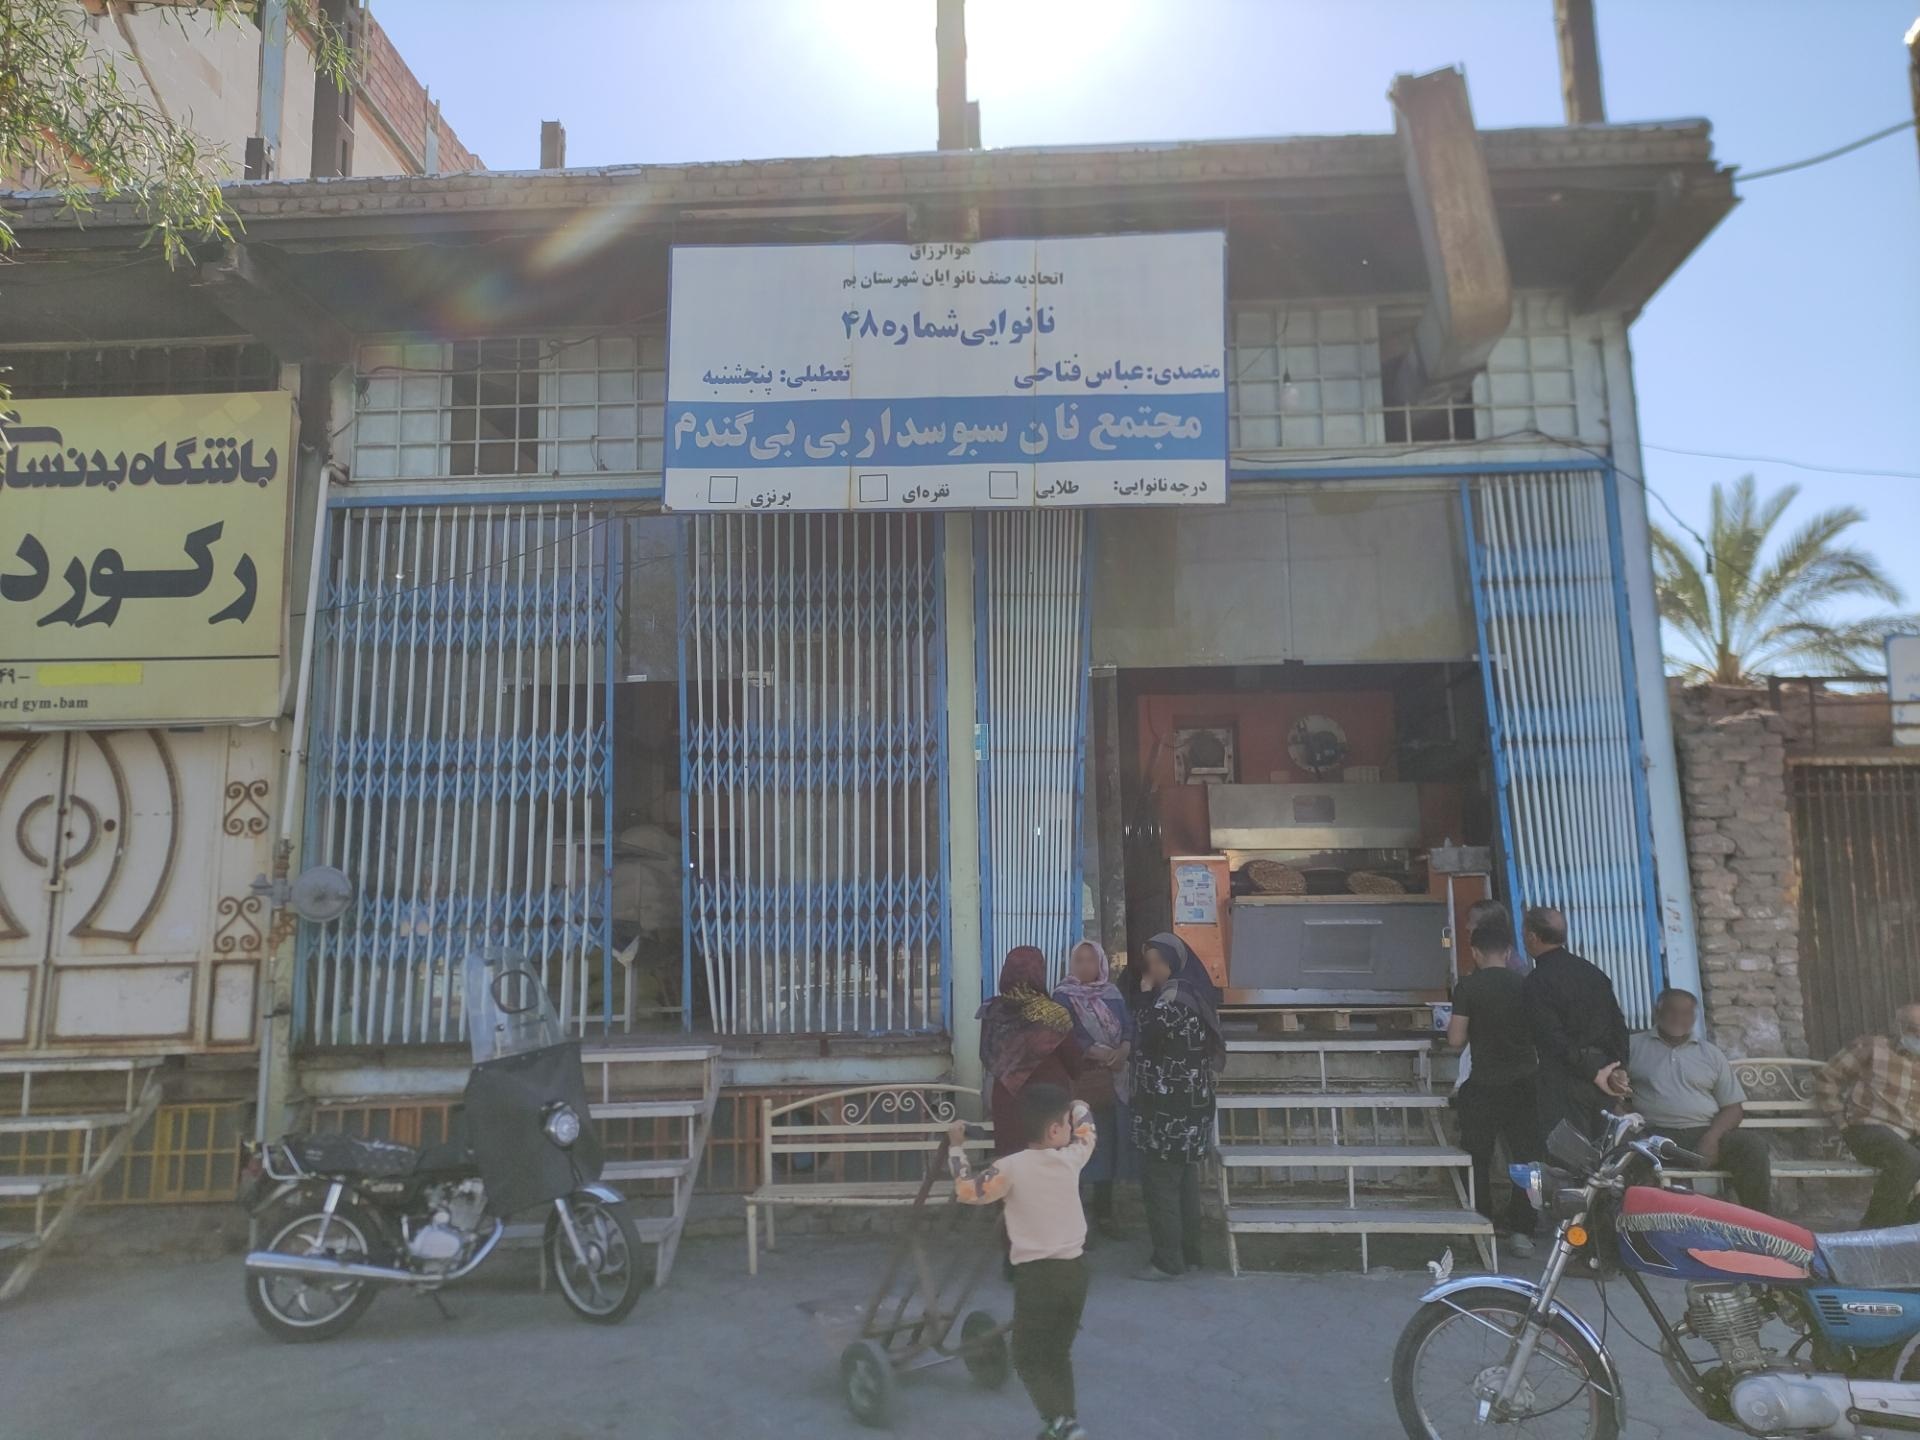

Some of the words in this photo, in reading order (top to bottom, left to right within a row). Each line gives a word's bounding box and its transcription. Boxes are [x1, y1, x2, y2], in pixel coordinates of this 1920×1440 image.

[842, 275, 857, 289] بم
[860, 270, 919, 289] شهرستان
[921, 269, 976, 288] نانوایان
[979, 274, 1012, 285] صنف
[1014, 271, 1064, 289] اتحادیه
[841, 309, 879, 340] ۴۸
[882, 309, 959, 345] شماره
[960, 305, 1055, 347] نانوایی
[702, 363, 774, 396] پنجشنبه
[779, 364, 851, 393] تعطیلی:
[1014, 353, 1082, 390] فتاحی
[1084, 359, 1144, 390] عباس
[1146, 362, 1221, 386] متصدی:
[674, 408, 755, 451] گندم
[749, 418, 797, 461] بی
[804, 418, 851, 460] بی
[855, 406, 1009, 459] سبوسدار
[1019, 401, 1080, 455] نان
[1089, 404, 1203, 452] مجتمع
[129, 437, 278, 488] باشگاه
[750, 489, 792, 509] برنزی
[1035, 479, 1080, 499] طلایی
[1113, 477, 1168, 497] نانوایی:
[1169, 478, 1208, 497] درجه
[0, 520, 258, 628] رکورد
[22, 696, 89, 712] gym.bam
